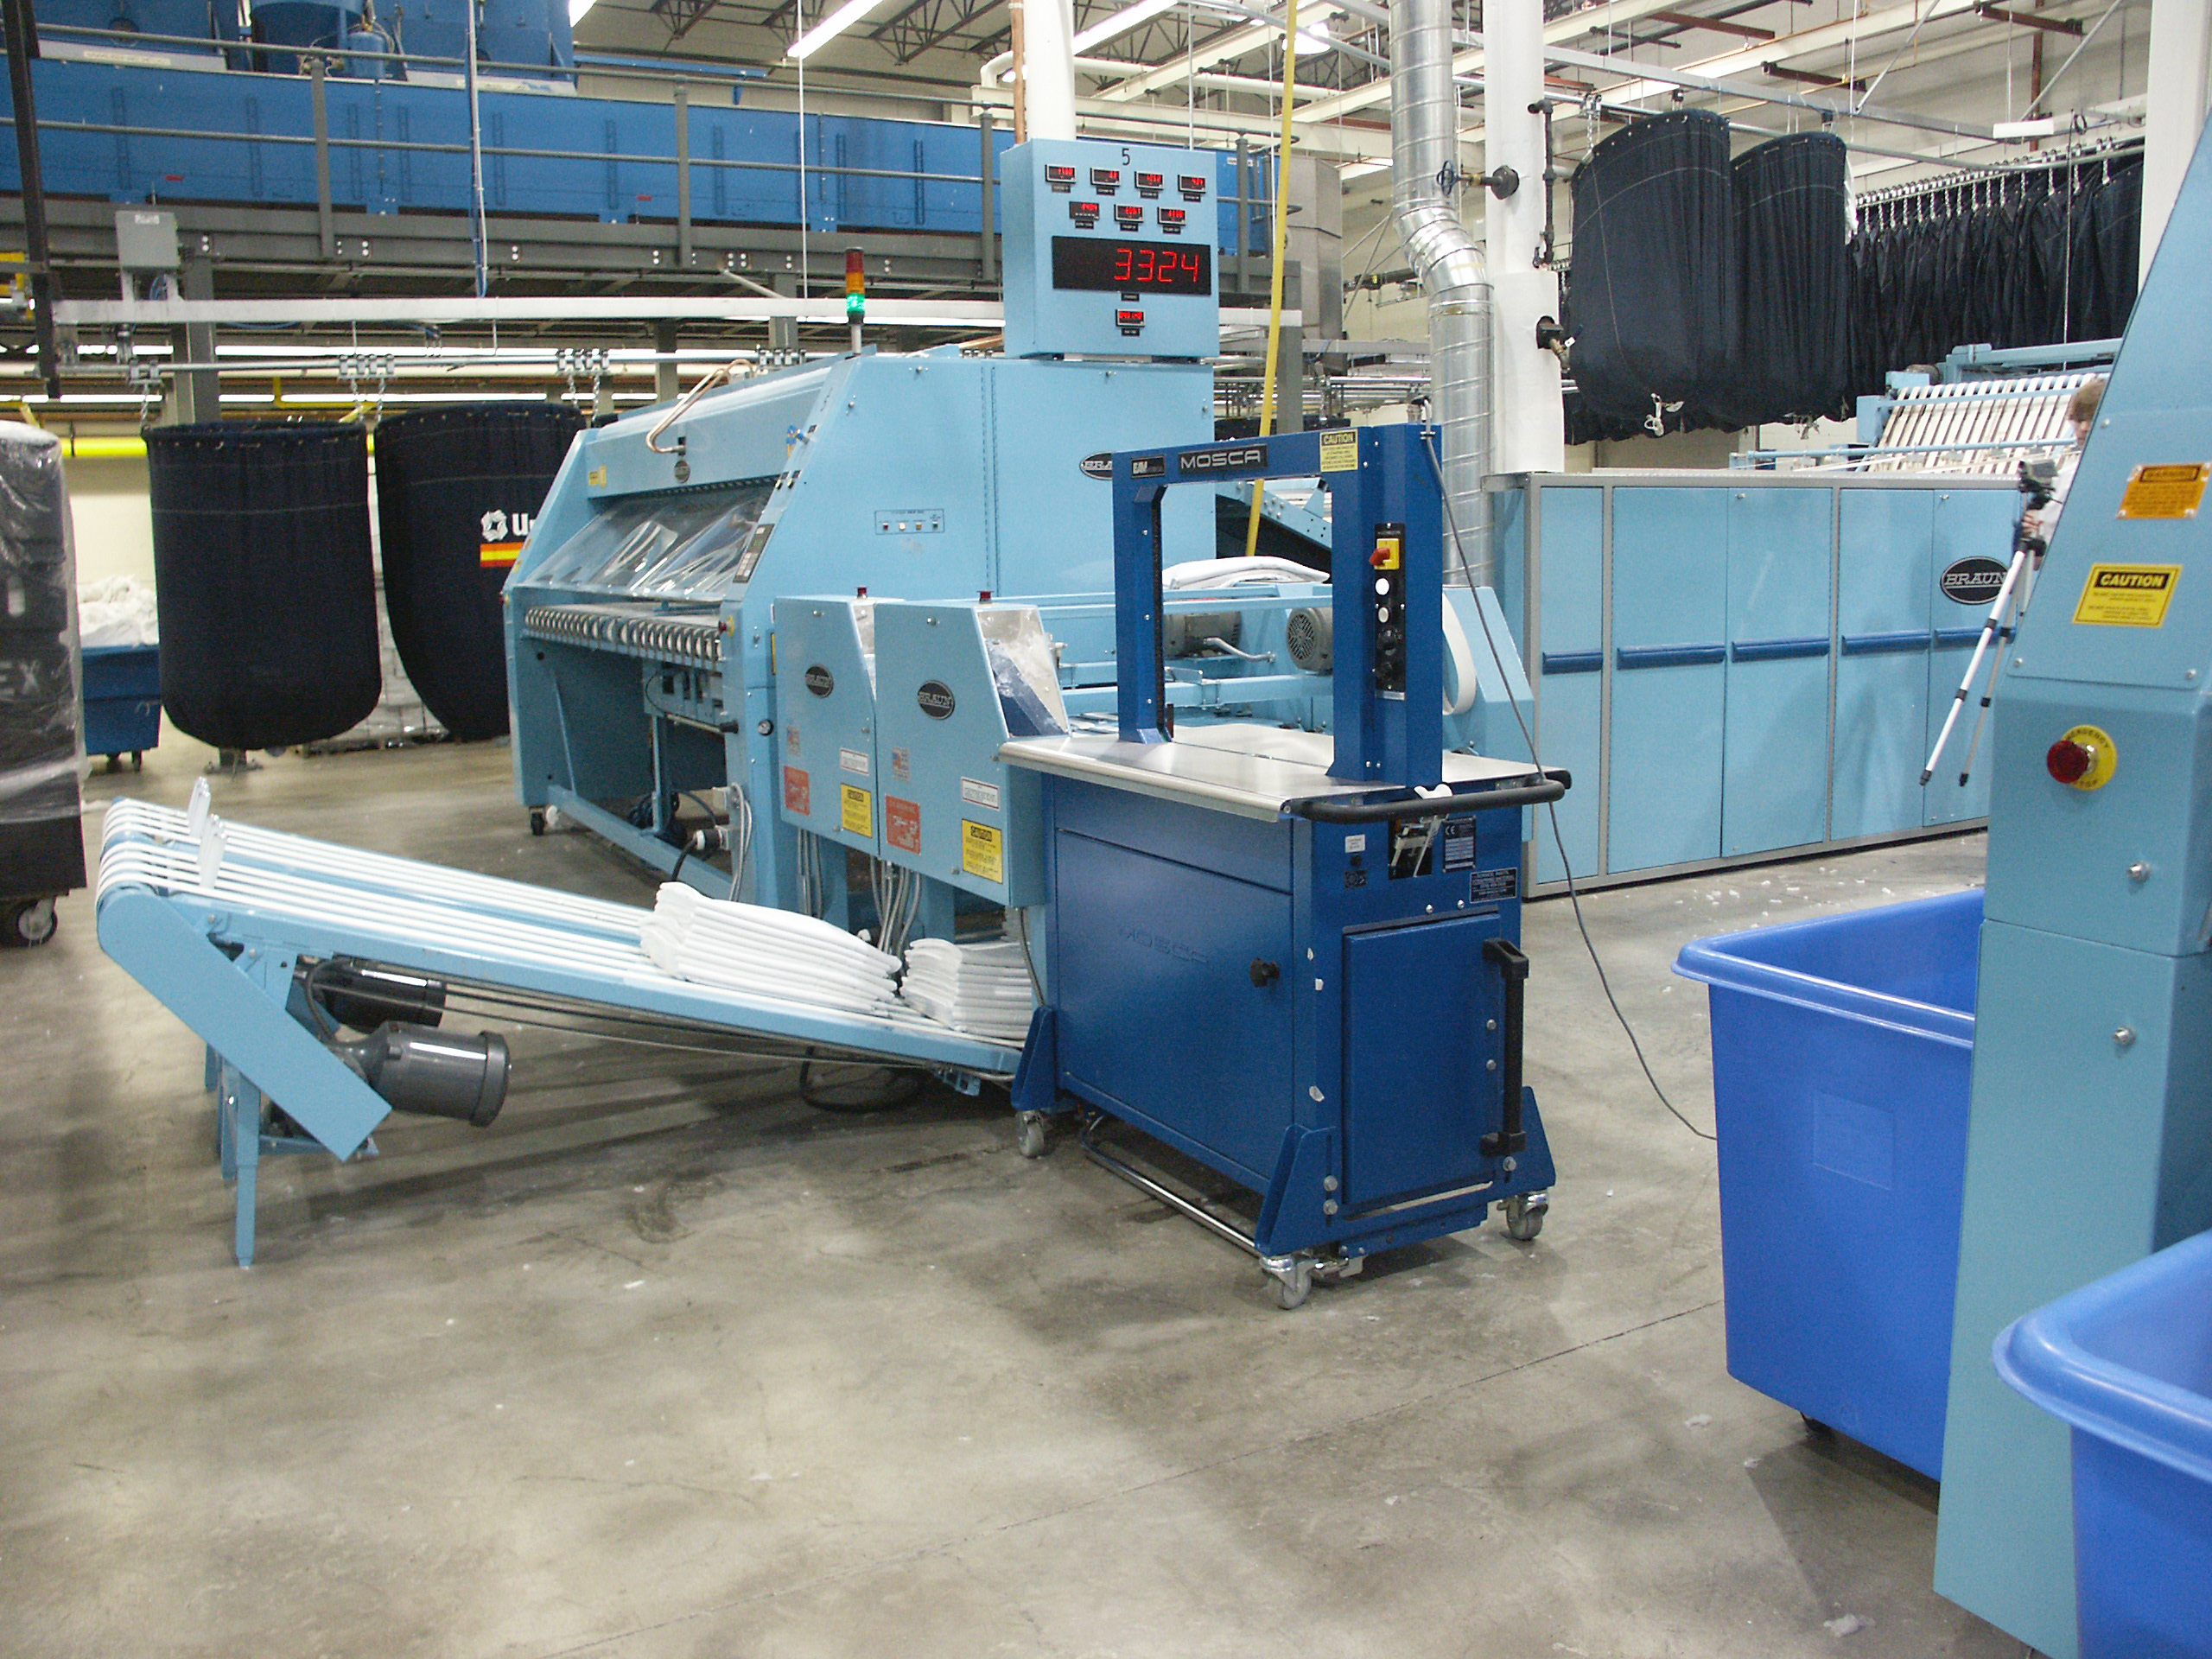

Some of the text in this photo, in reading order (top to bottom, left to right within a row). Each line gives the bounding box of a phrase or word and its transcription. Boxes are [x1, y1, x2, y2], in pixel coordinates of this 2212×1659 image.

[1122, 149, 1131, 166] 5
[1115, 247, 1199, 283] 3324
[1324, 433, 1354, 444] CAUTION
[1180, 449, 1262, 469] MOSCA
[1944, 572, 2008, 586] BRAUN
[2100, 574, 2164, 588] CAUTION
[918, 691, 953, 709] BRAUN
